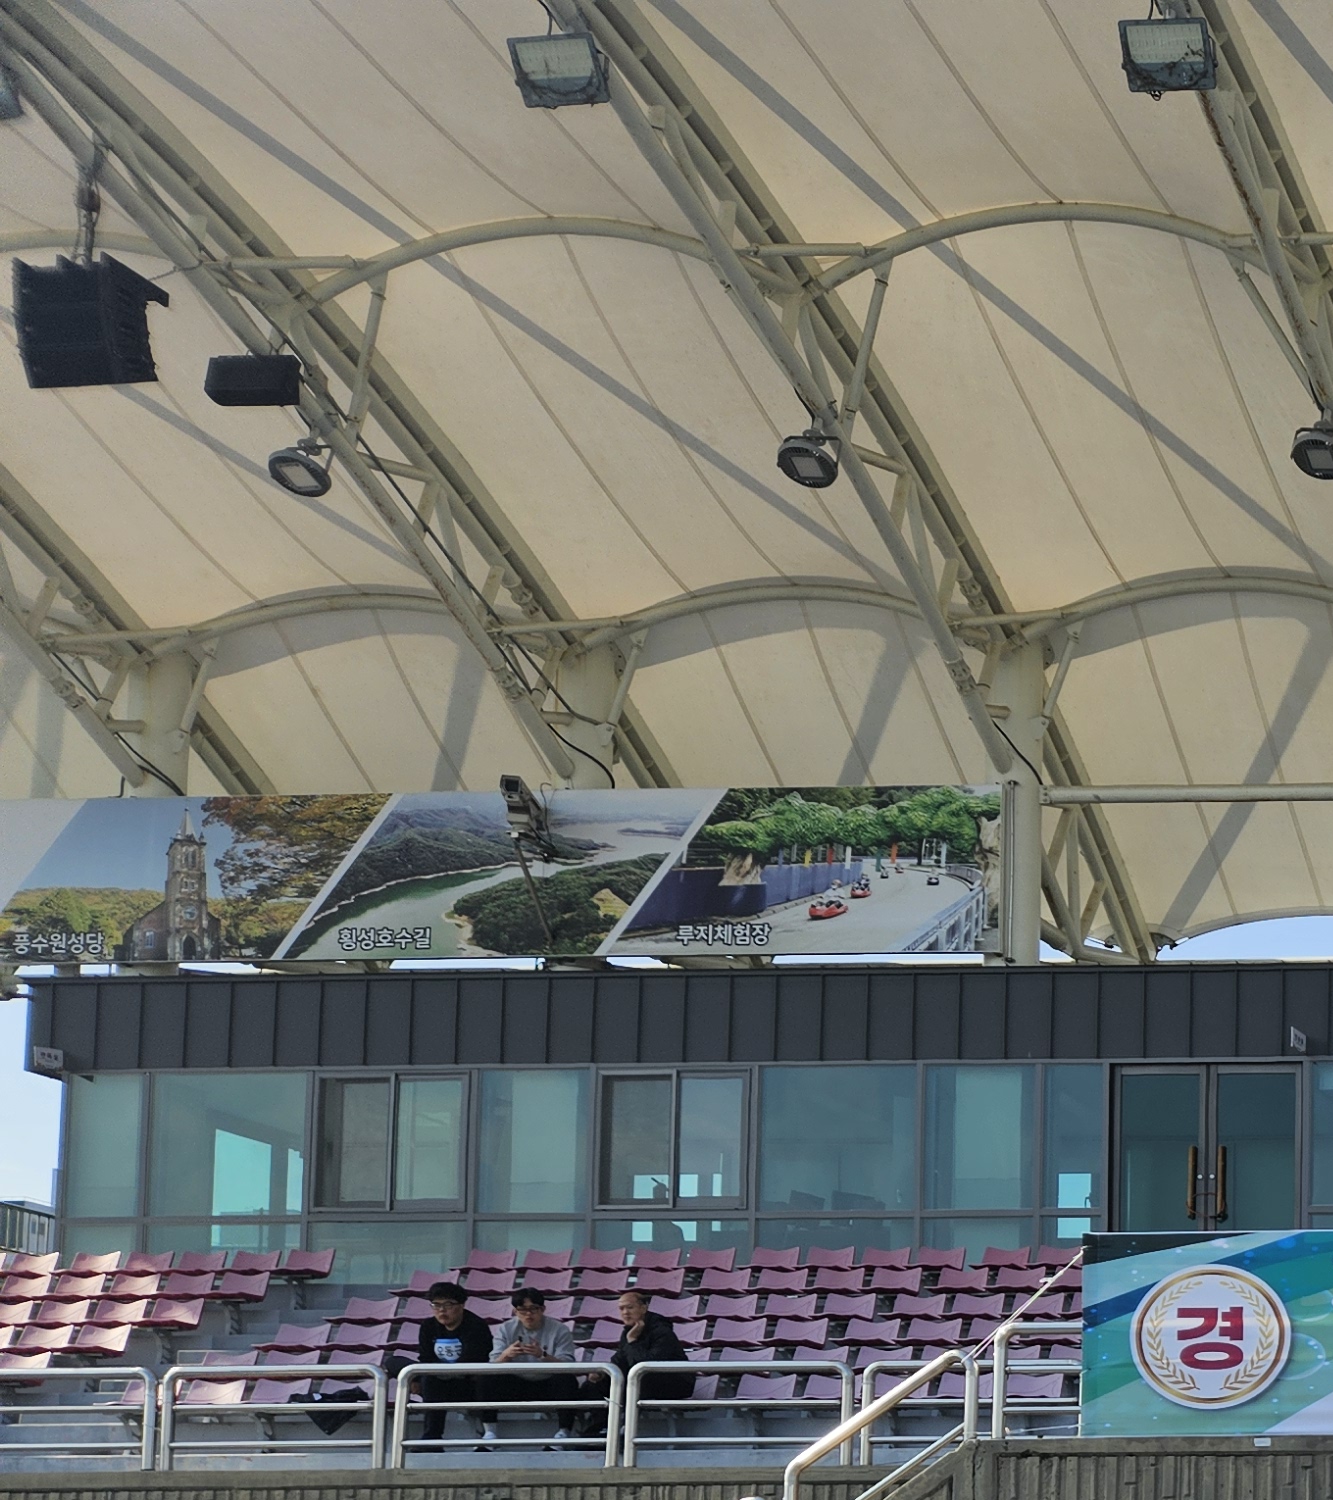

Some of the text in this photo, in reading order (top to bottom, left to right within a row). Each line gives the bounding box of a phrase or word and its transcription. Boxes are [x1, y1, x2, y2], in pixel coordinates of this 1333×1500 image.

[12, 931, 105, 955] 풍수원성당
[337, 926, 432, 950] 횡성호수길
[675, 922, 772, 946] 루지체험장
[1176, 1306, 1245, 1371] 경
